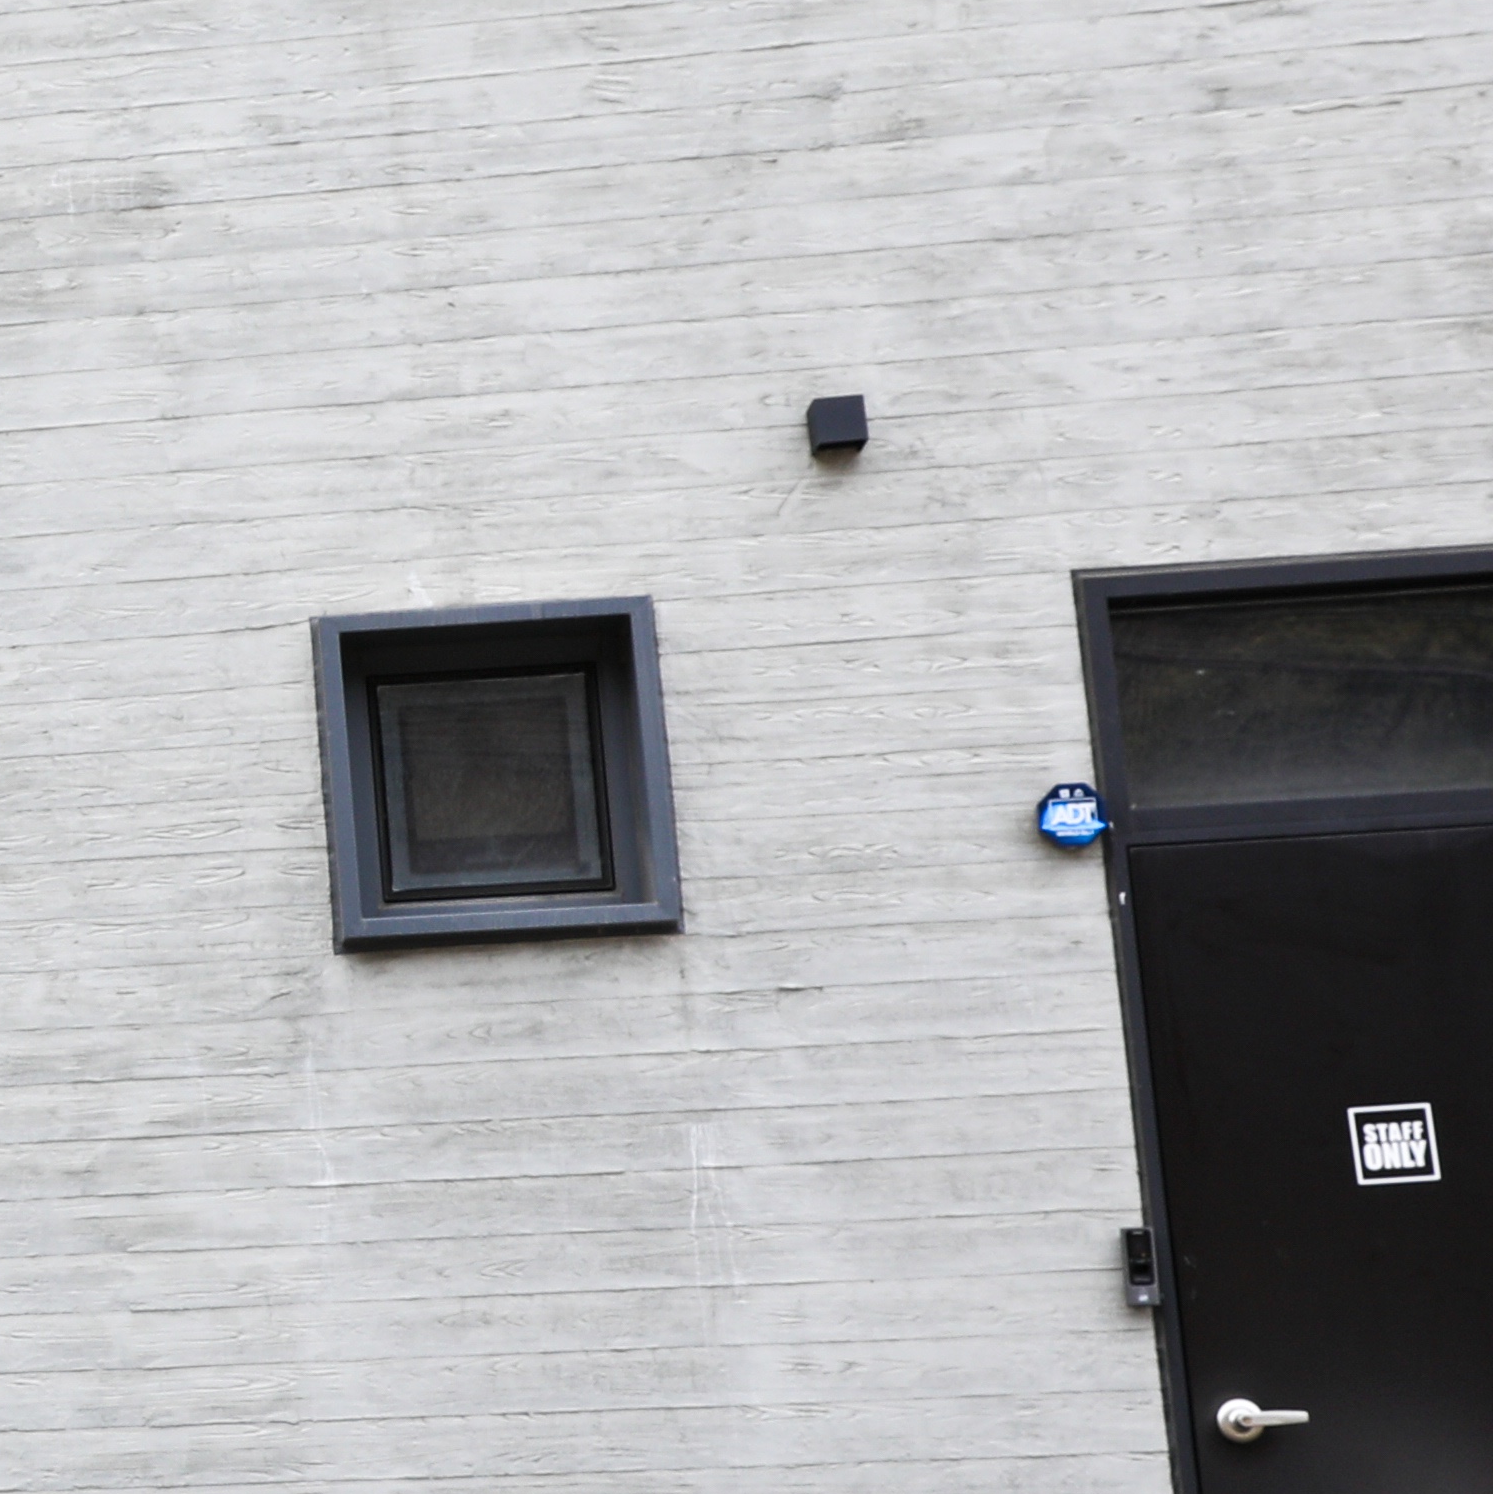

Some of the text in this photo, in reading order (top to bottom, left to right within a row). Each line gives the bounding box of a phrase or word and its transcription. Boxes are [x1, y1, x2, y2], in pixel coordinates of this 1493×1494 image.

[1050, 802, 1097, 826] ADT
[1362, 1120, 1424, 1144] STAFF
[1362, 1139, 1427, 1171] ONLY
